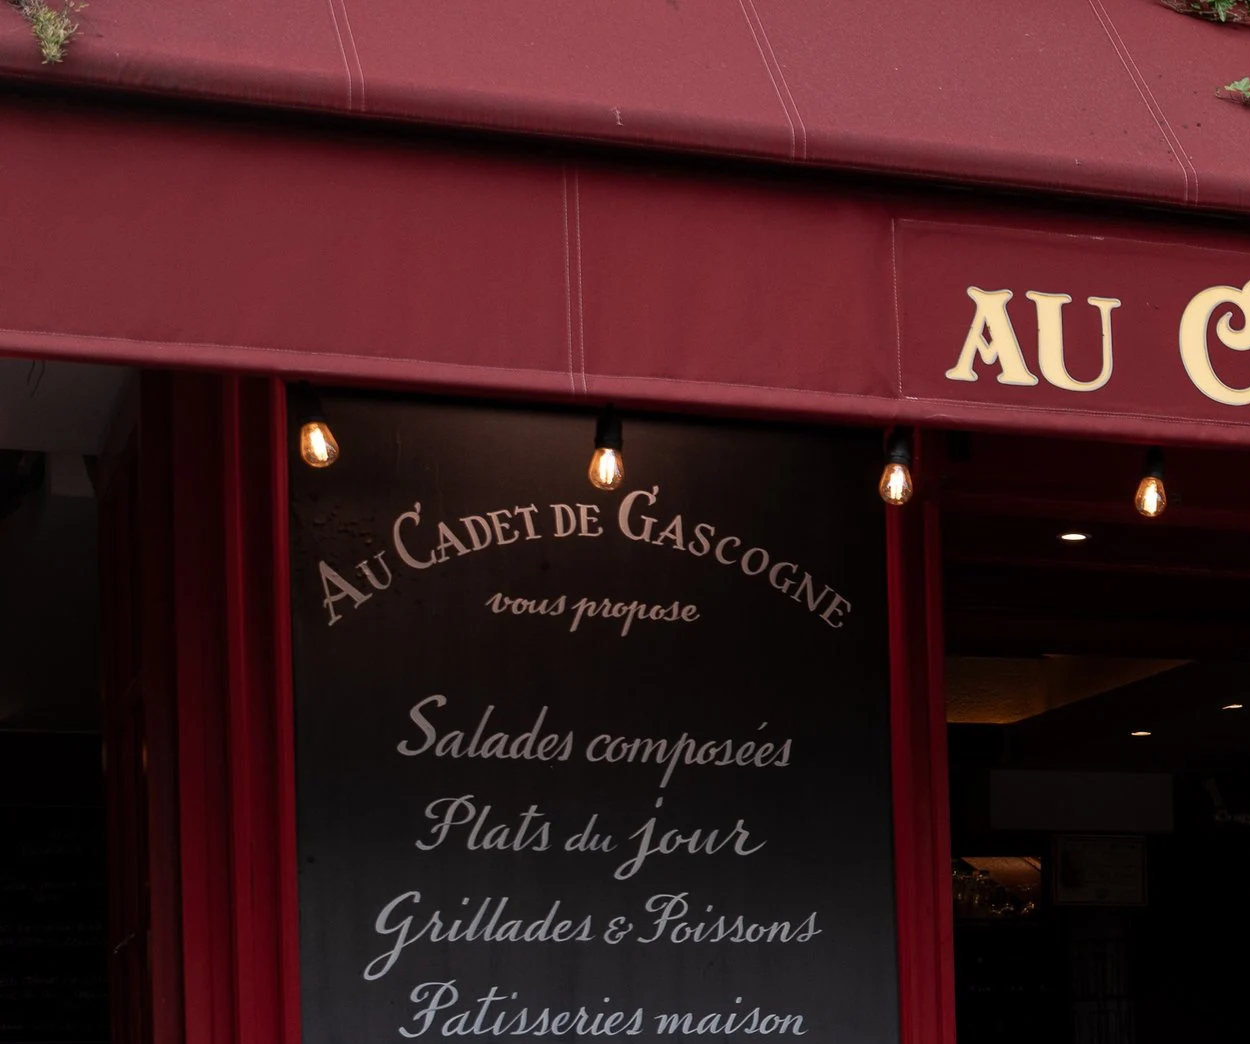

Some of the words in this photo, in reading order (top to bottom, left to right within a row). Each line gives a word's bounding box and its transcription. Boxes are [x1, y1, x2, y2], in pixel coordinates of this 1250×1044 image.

[945, 286, 1121, 392] AU
[319, 550, 393, 627] AU
[392, 502, 542, 569] CADET
[618, 485, 852, 629] GASCOGNE
[485, 592, 567, 617] vous
[570, 598, 701, 638] propose
[397, 694, 573, 761] Salades
[585, 722, 793, 789] composées
[415, 794, 552, 852] Plats
[564, 814, 617, 852] du
[613, 797, 767, 881] jour
[363, 890, 596, 981] Grillades
[603, 915, 634, 945] &
[636, 892, 823, 943] Poissons
[398, 979, 643, 1038] Patisseries
[653, 996, 808, 1036] maison
